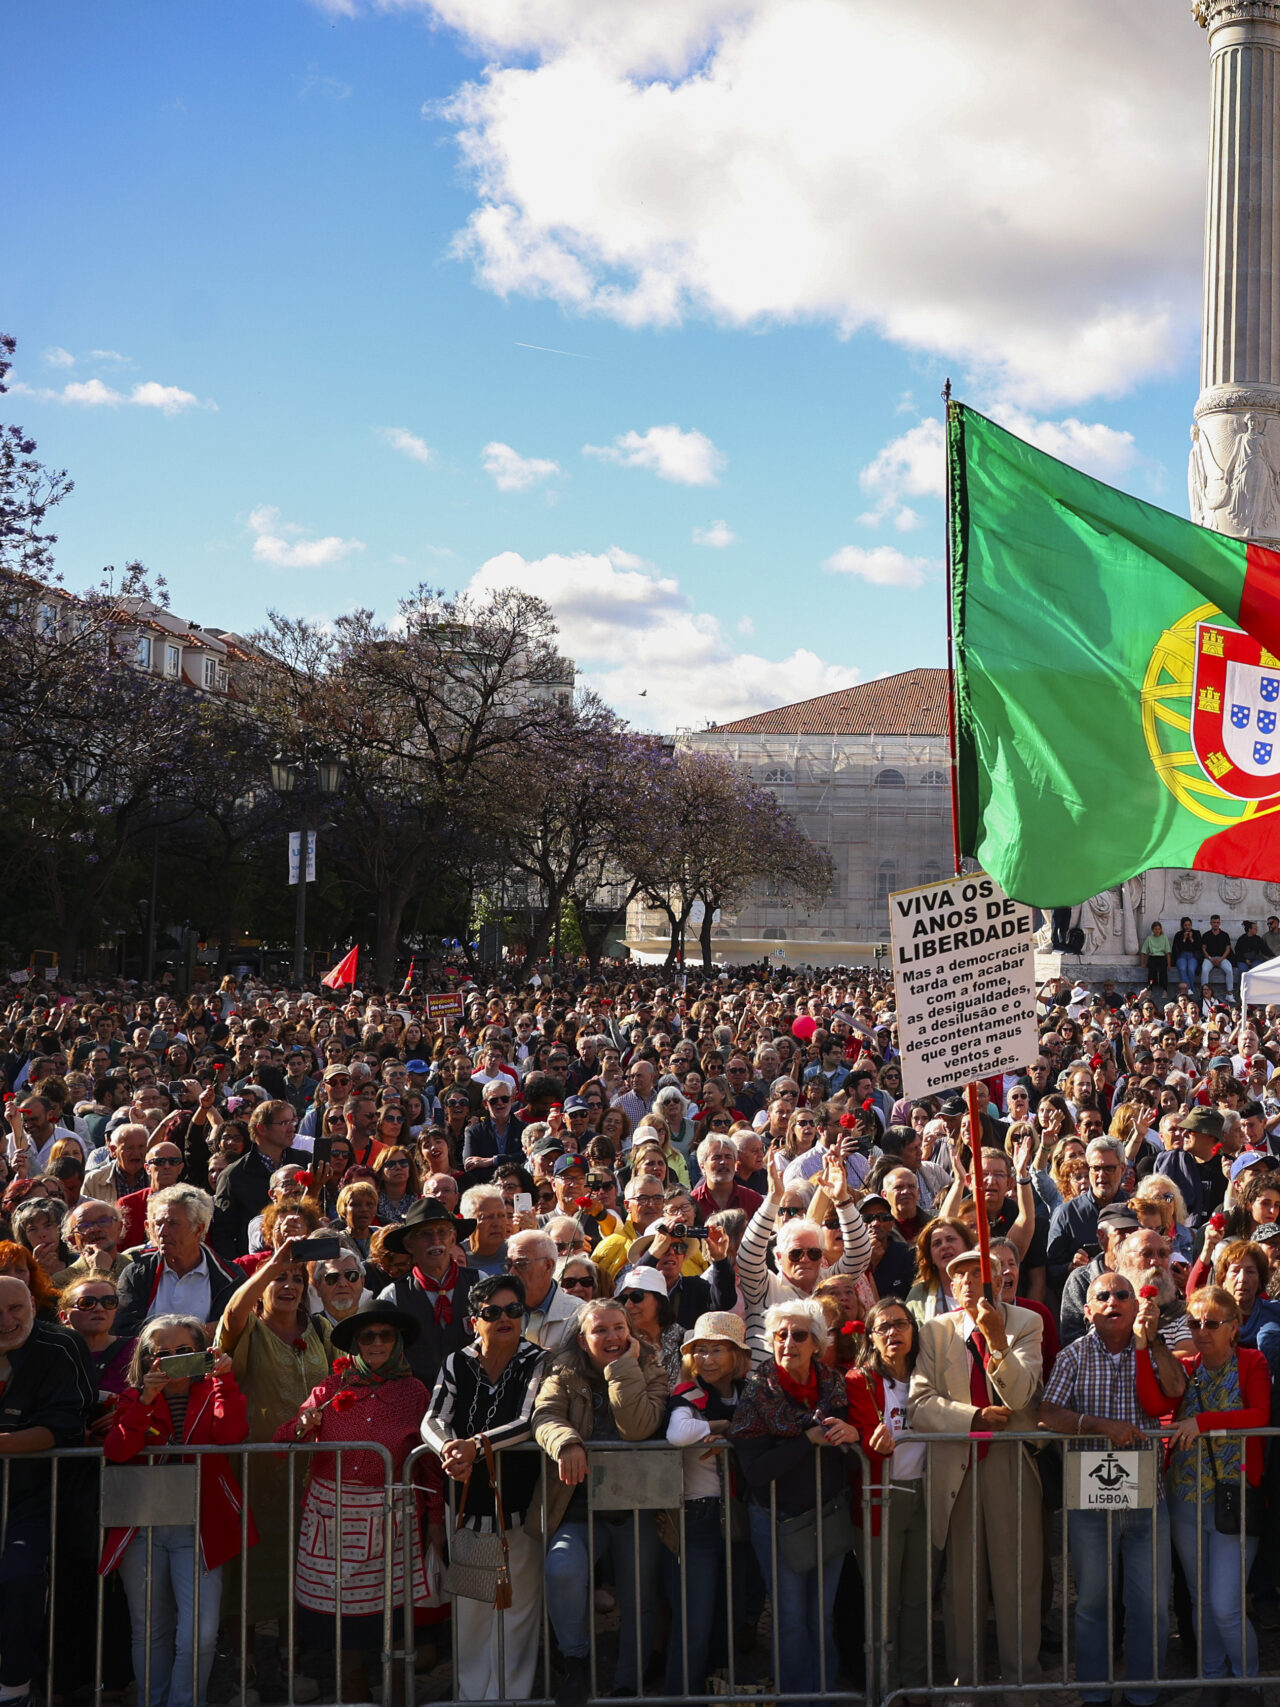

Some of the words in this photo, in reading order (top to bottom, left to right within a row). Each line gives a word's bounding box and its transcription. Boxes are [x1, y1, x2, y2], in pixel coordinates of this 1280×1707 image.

[897, 890, 955, 918] VIVA
[962, 880, 994, 902] OS
[912, 906, 978, 938] ANOS
[986, 898, 1016, 920] DE
[899, 915, 1031, 964] LIBERDADE
[902, 968, 932, 983] Mas
[936, 965, 945, 975] a
[948, 942, 1030, 972] democracia
[910, 978, 948, 995] tarda
[952, 972, 973, 985] em
[977, 957, 1025, 978] acabar
[907, 1015, 924, 1025] as
[928, 984, 1031, 1019] desigualdades,
[926, 990, 956, 1005] com
[960, 987, 969, 996] a
[972, 976, 1011, 993] fome,
[906, 1010, 1035, 1053] descontentamento
[918, 1025, 927, 1035] a
[931, 1006, 997, 1032] desilusão
[1001, 1003, 1010, 1012] e
[1013, 1000, 1022, 1009] o
[921, 1047, 947, 1063] que
[950, 1037, 982, 1055] gera
[986, 1026, 1022, 1043] maus
[944, 1049, 990, 1068] ventos
[993, 1045, 1002, 1055] e
[927, 1053, 1020, 1087] tempestades.
[1088, 1493, 1130, 1504] LISBOA
